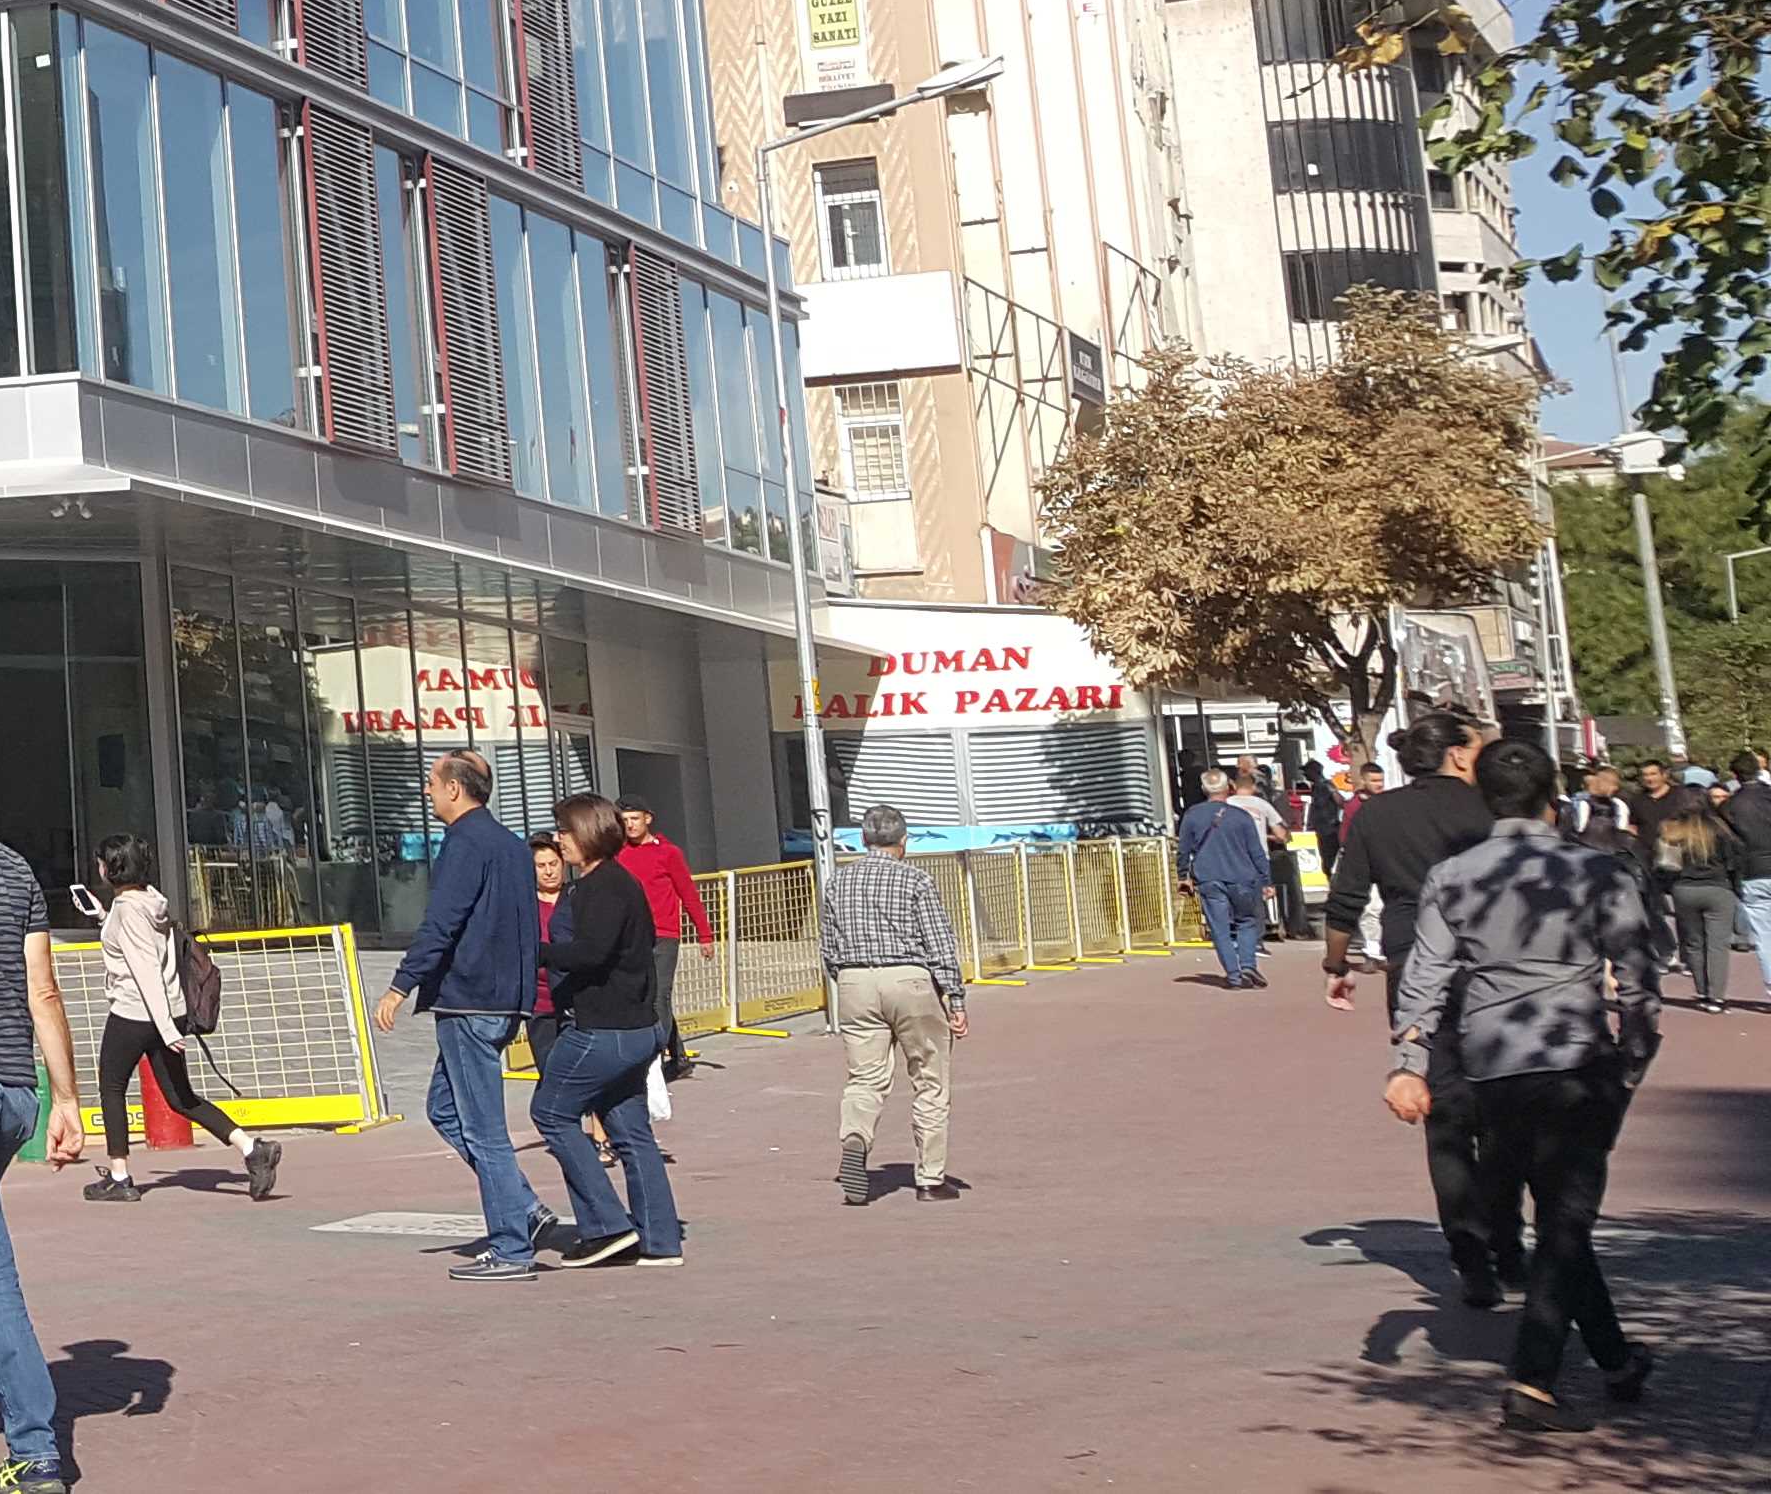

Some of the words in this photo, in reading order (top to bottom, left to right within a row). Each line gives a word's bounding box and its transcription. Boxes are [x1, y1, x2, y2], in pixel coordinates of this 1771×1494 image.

[818, 10, 848, 25] YAZI
[812, 27, 858, 44] SANATI
[866, 646, 1033, 678] DUMAN
[954, 684, 1125, 714] PAZARI
